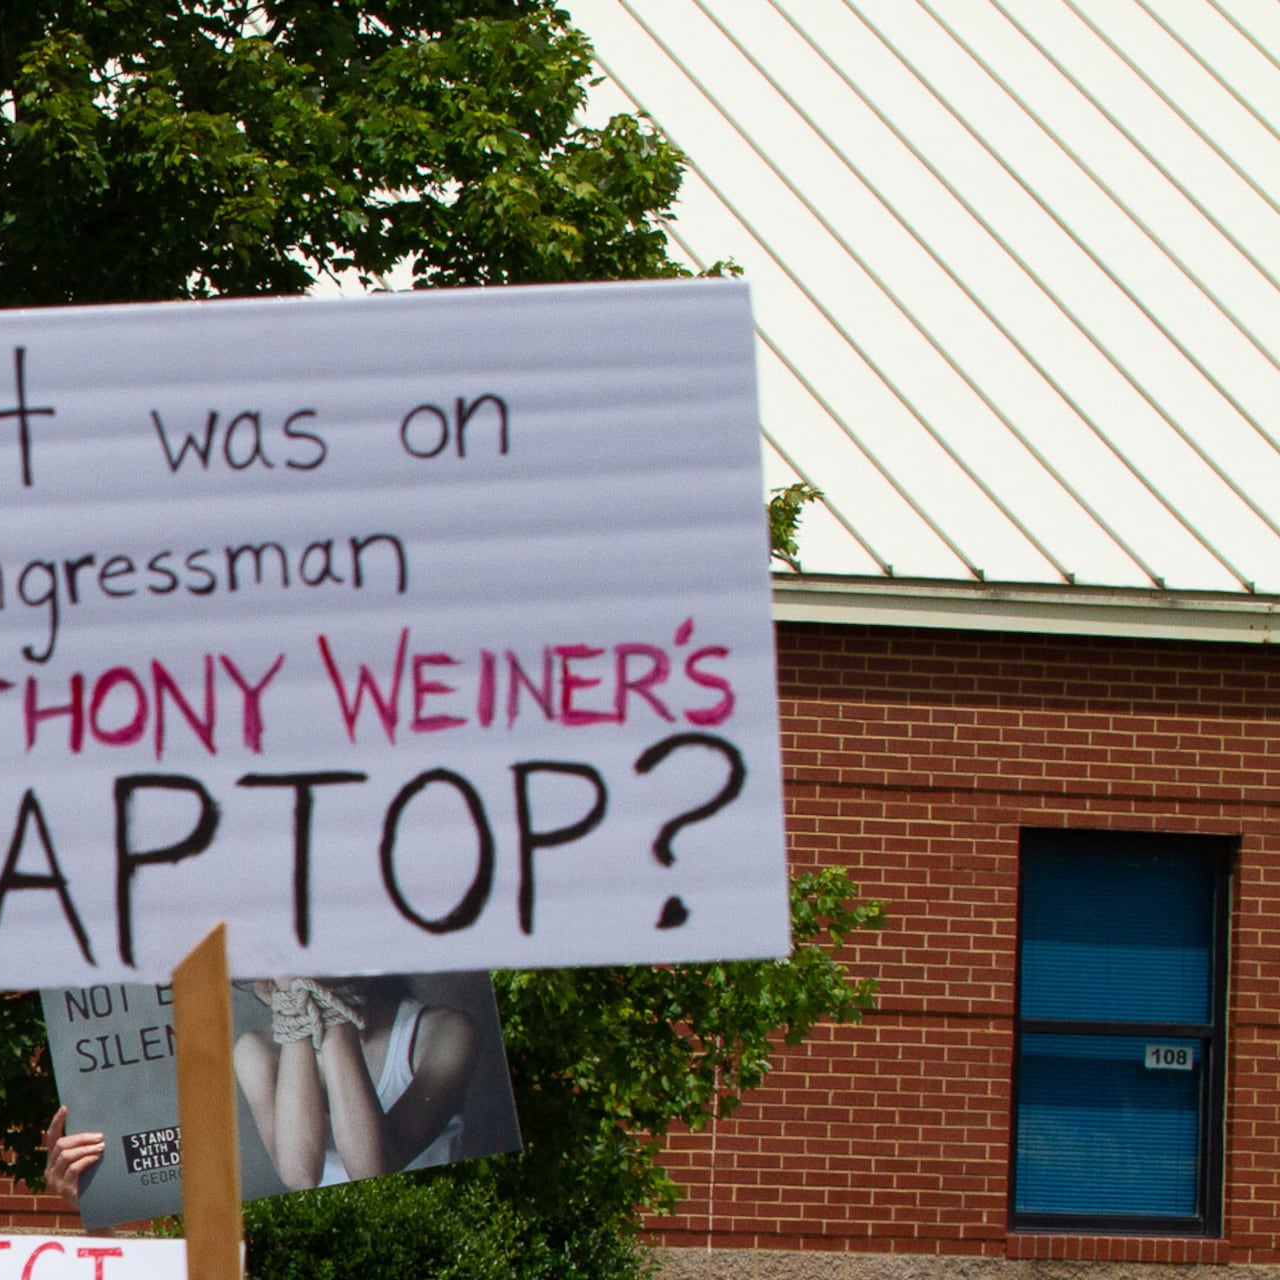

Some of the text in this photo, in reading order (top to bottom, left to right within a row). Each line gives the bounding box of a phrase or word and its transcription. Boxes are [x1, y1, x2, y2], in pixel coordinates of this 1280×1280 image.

[151, 406, 328, 473] was
[400, 392, 509, 460] on
[319, 618, 737, 744] WEINER'S
[1151, 1049, 1188, 1066] 108
[139, 1142, 168, 1156] WITH
